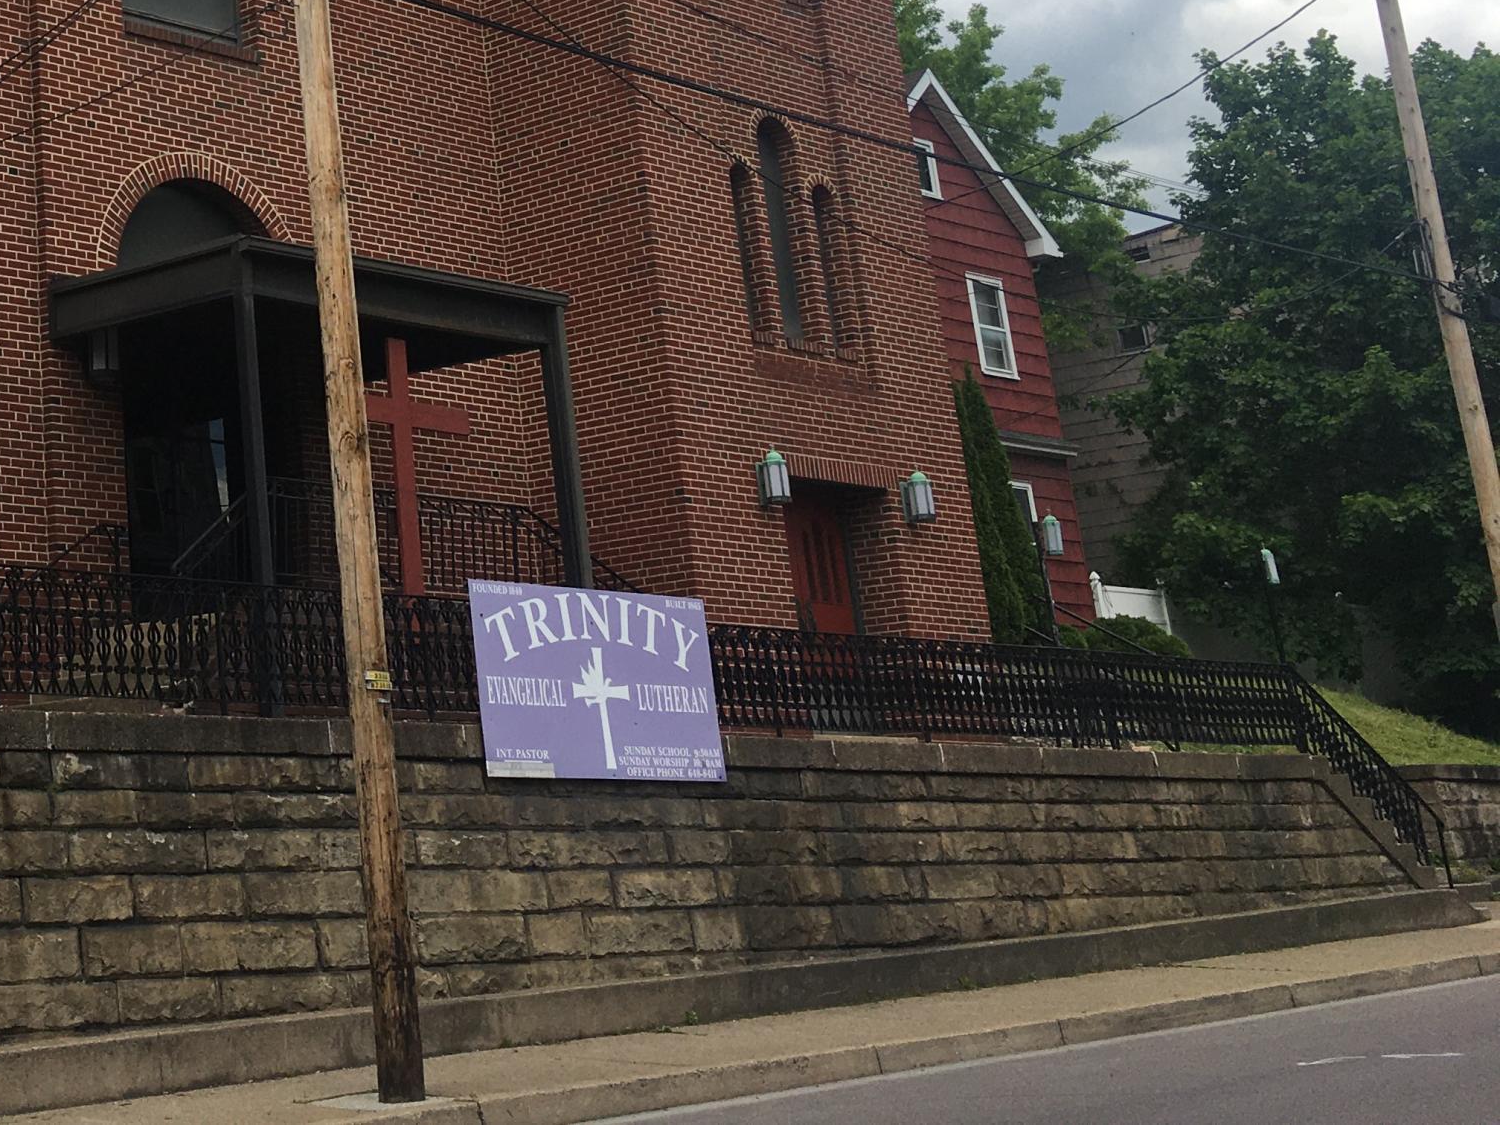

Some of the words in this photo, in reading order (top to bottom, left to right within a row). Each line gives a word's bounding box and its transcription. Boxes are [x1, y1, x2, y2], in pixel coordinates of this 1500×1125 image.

[471, 582, 508, 595] FOUNDED
[484, 592, 699, 672] TRINITY
[486, 675, 567, 707] EVANGELICAL
[636, 683, 709, 714] LUTHERAN
[496, 748, 515, 759] INT.
[516, 749, 550, 760] PASTOR
[623, 746, 657, 756] SUNDAY
[658, 747, 692, 757] SCHOOL
[618, 756, 652, 766] SUNDAY
[652, 757, 690, 767] WORSHIP
[627, 766, 655, 777] OFFICE
[656, 767, 685, 778] PHONE
